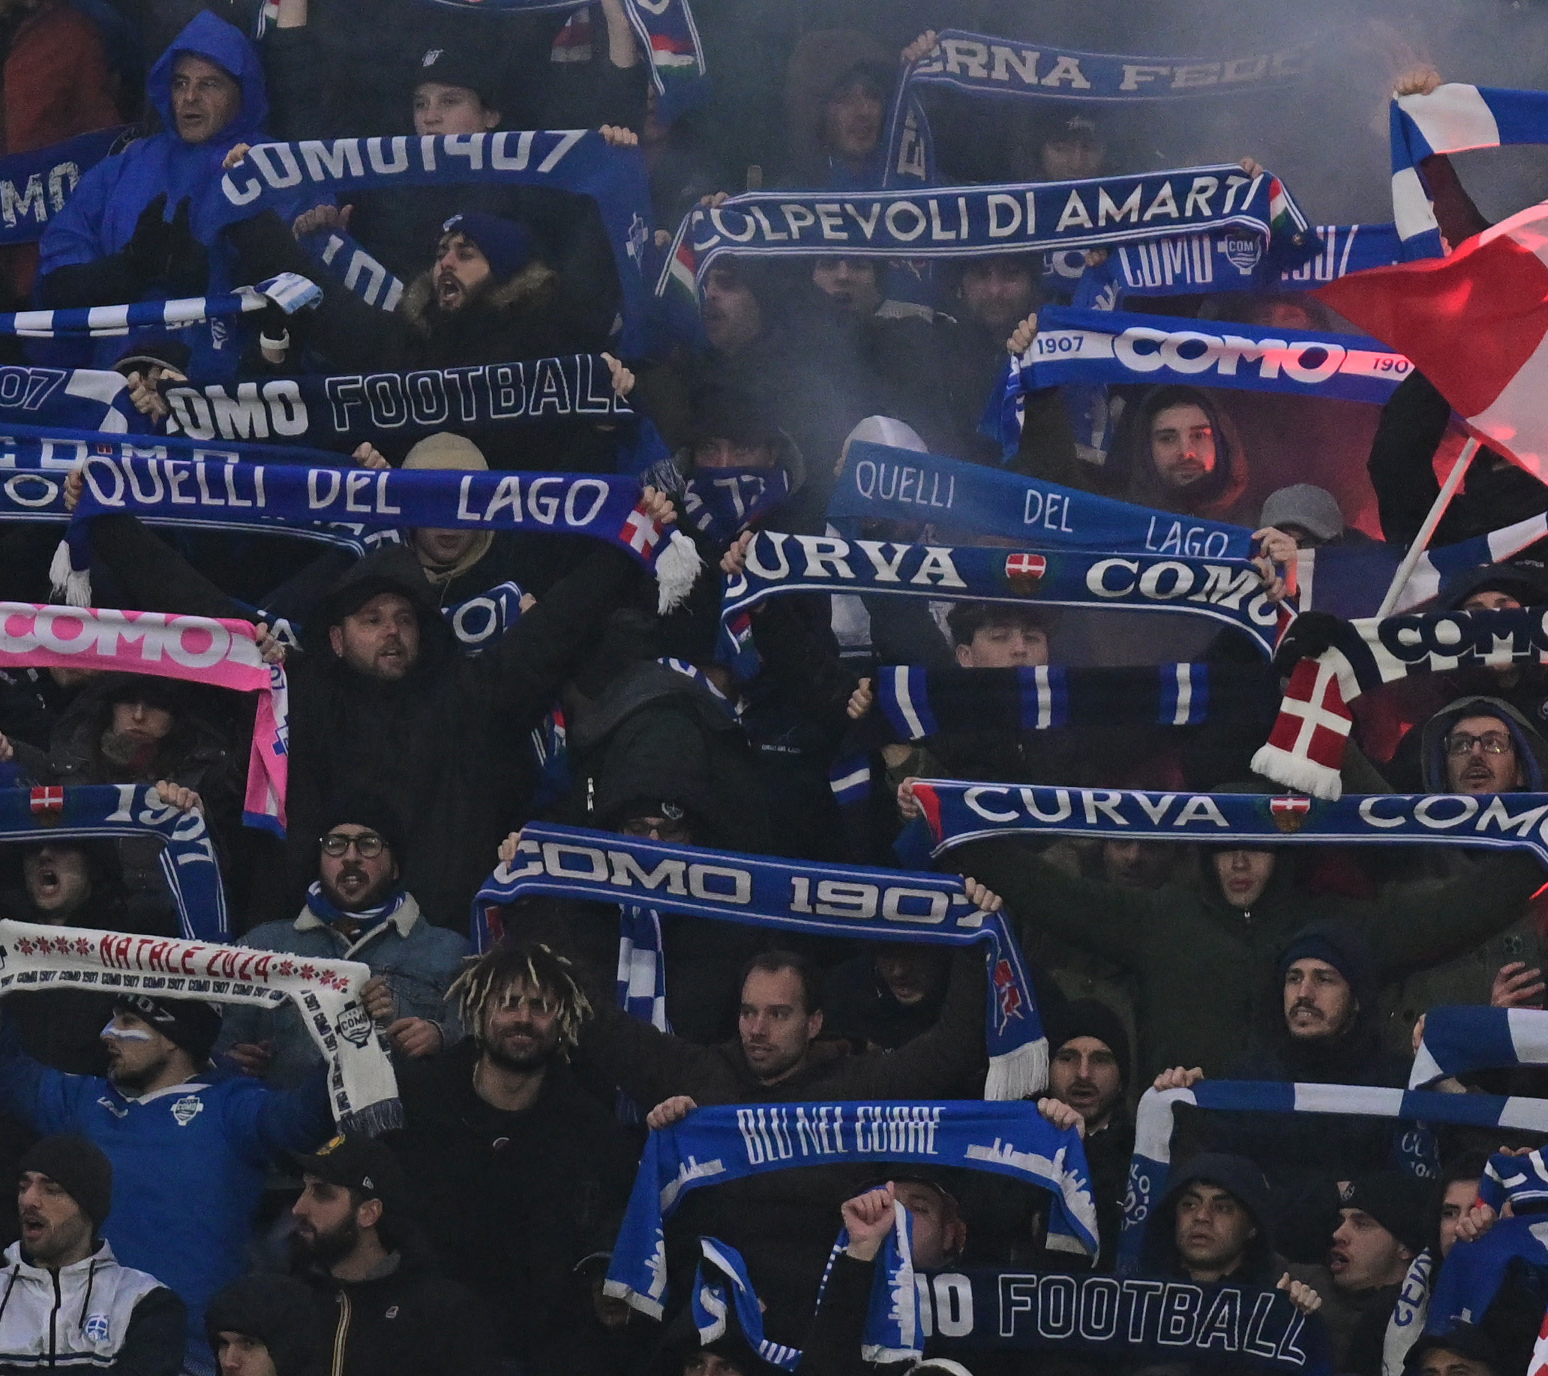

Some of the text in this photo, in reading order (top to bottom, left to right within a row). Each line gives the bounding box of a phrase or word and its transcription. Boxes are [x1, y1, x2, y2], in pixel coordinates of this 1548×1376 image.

[692, 191, 969, 250] COLPEVOLI
[986, 191, 1036, 238] DI
[1036, 324, 1349, 385] 1907 COMO
[83, 453, 610, 527] QUELLI DEL LAGO
[855, 460, 1231, 559] QUELLI DEL LAGO
[723, 531, 969, 599] CURVA
[961, 783, 1233, 831] CURVA
[492, 837, 755, 907] COMO
[97, 934, 273, 984] NATALE 2024
[798, 1105, 852, 1156] NEL
[854, 1105, 946, 1155] CUORE
